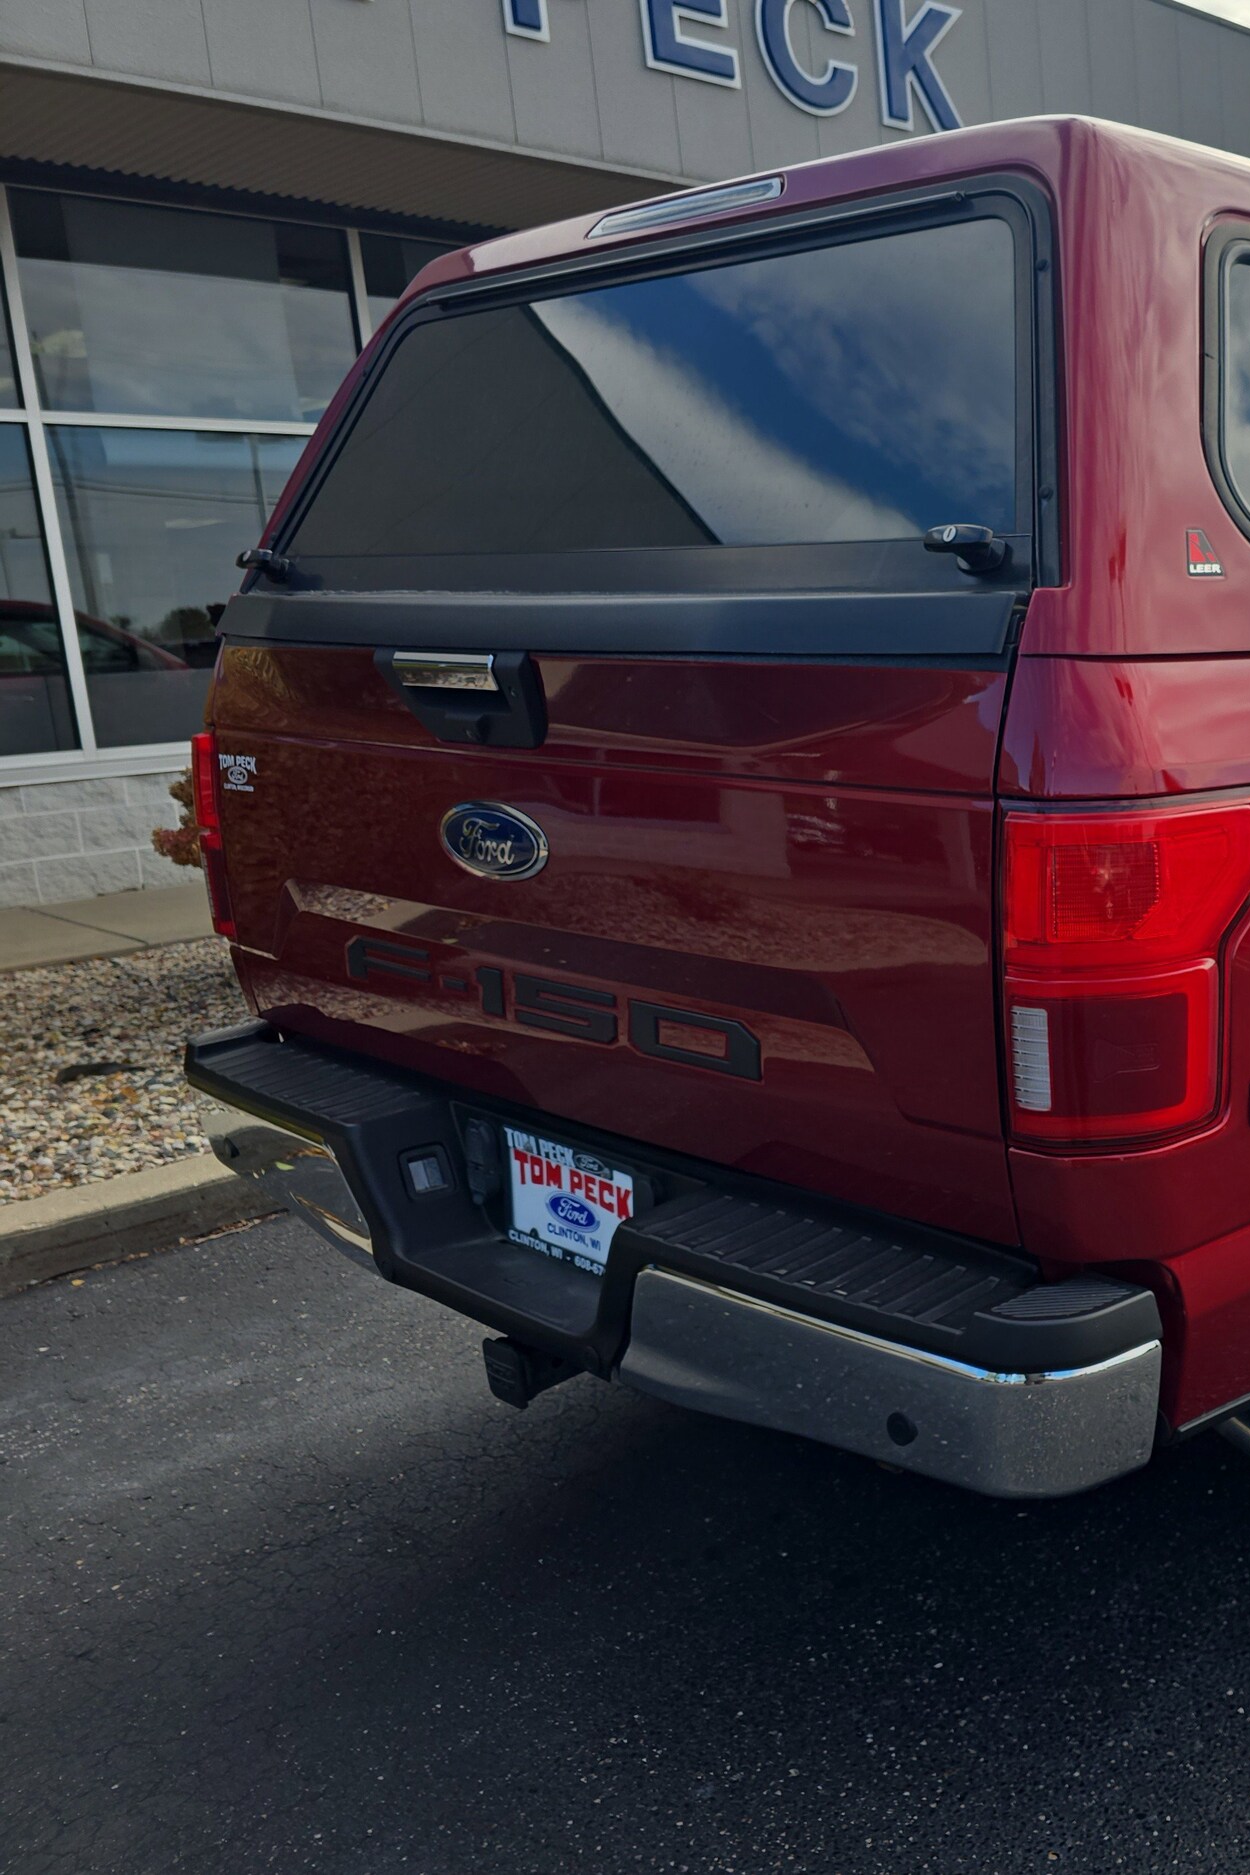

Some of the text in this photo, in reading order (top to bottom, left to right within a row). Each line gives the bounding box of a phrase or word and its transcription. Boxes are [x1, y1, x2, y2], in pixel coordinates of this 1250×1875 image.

[504, 0, 967, 132] ECK
[1189, 563, 1222, 574] LEER
[218, 753, 258, 775] TOM PECK
[459, 816, 516, 865] Ford
[346, 935, 763, 1083] F-150
[538, 1138, 577, 1169] PECK
[513, 1148, 633, 1220] TOM PECK
[556, 1197, 589, 1226] Ford
[508, 1229, 550, 1257] CLINTON,
[547, 1222, 602, 1252] CLINTON, WI
